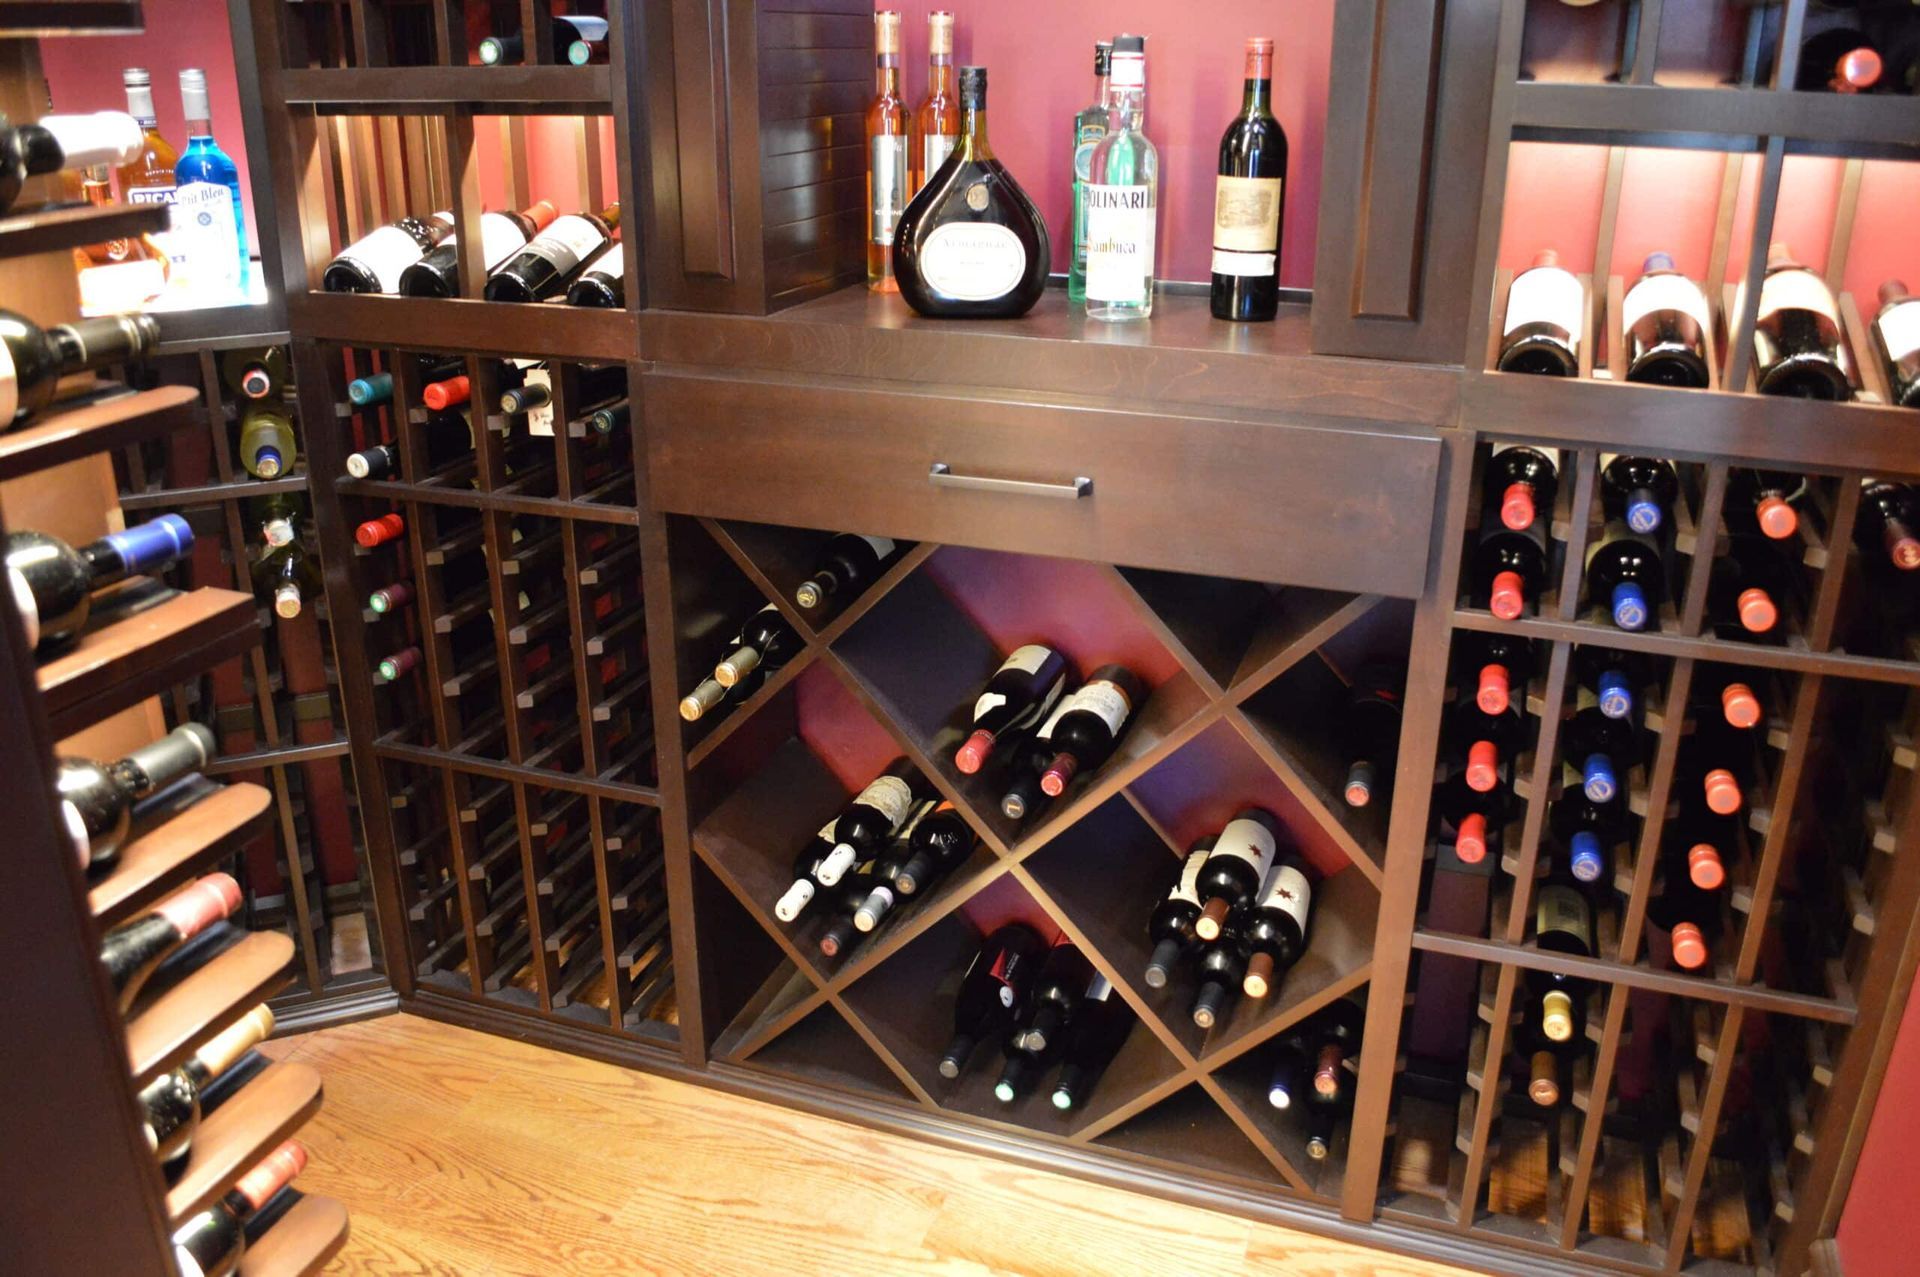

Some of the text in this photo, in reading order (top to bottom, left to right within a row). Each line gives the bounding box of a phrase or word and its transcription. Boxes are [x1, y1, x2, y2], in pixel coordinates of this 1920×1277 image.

[132, 191, 178, 204] RICA
[201, 186, 225, 202] Bleu
[1089, 189, 1145, 209] OLINARI
